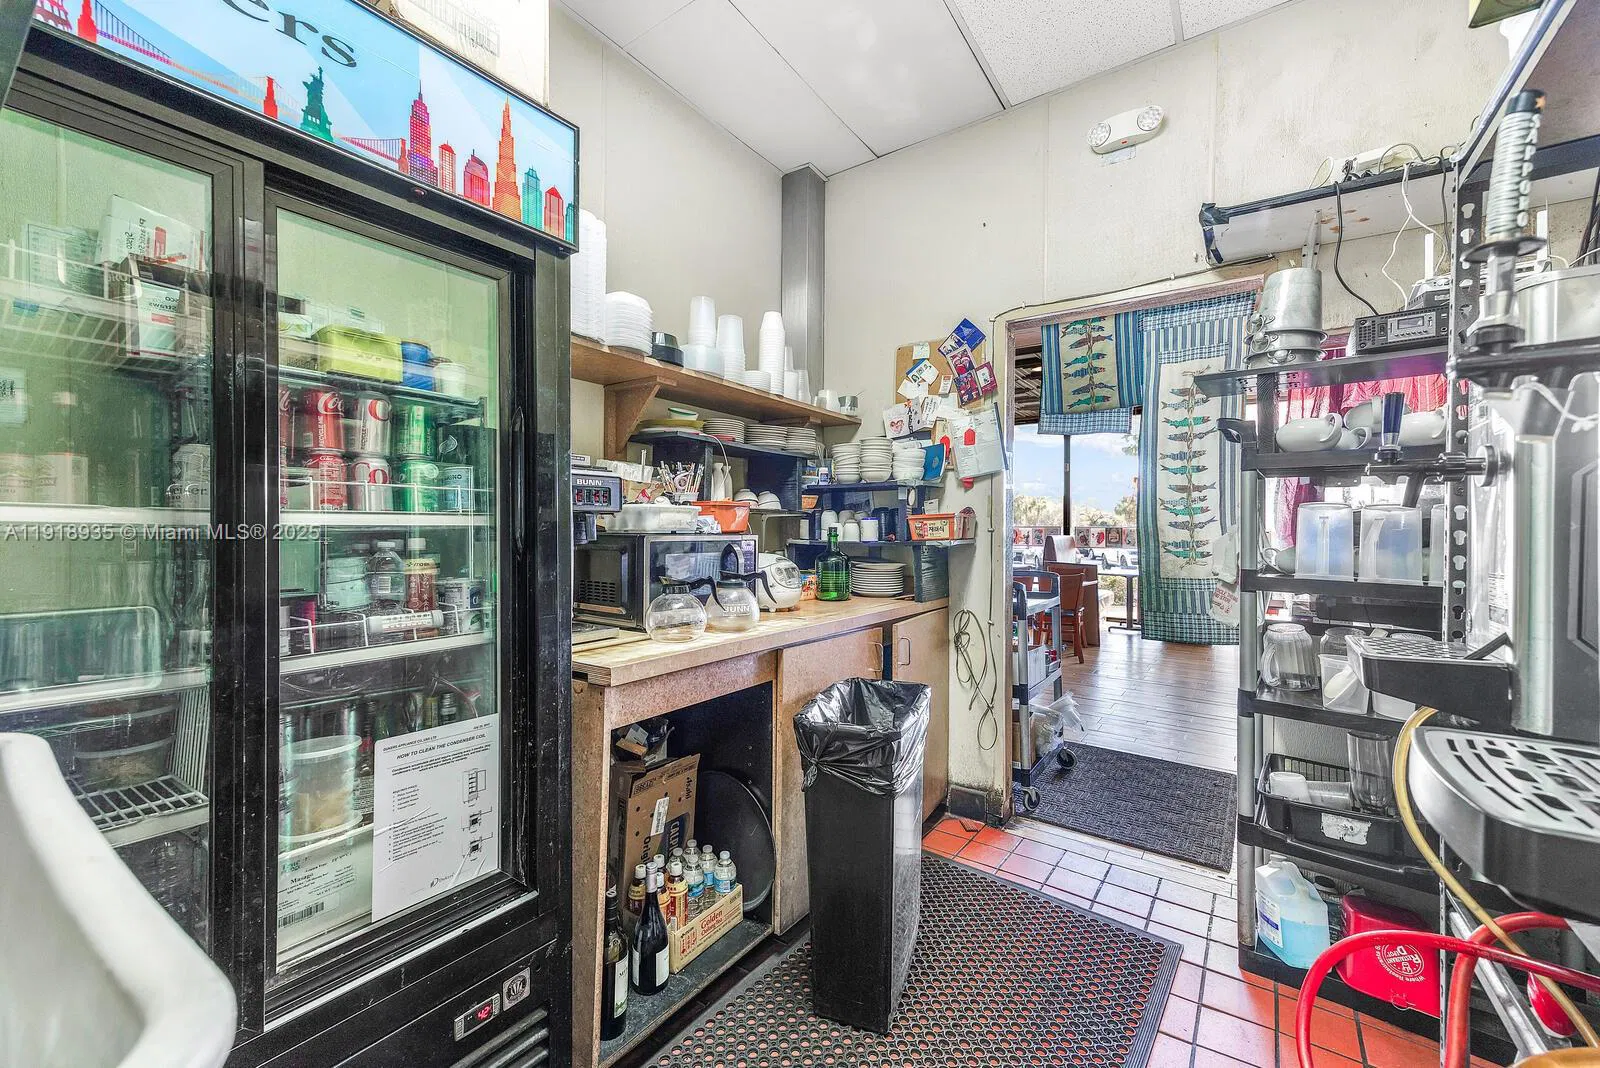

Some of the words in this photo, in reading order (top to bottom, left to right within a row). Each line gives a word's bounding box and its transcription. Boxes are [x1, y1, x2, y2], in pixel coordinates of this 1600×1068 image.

[1517, 113, 1541, 228] SAPPORO
[576, 478, 602, 486] BUNN
[397, 752, 411, 760] HOW
[419, 745, 436, 754] CLEAN
[685, 777, 693, 800] Asahi
[701, 910, 723, 929] Golden
